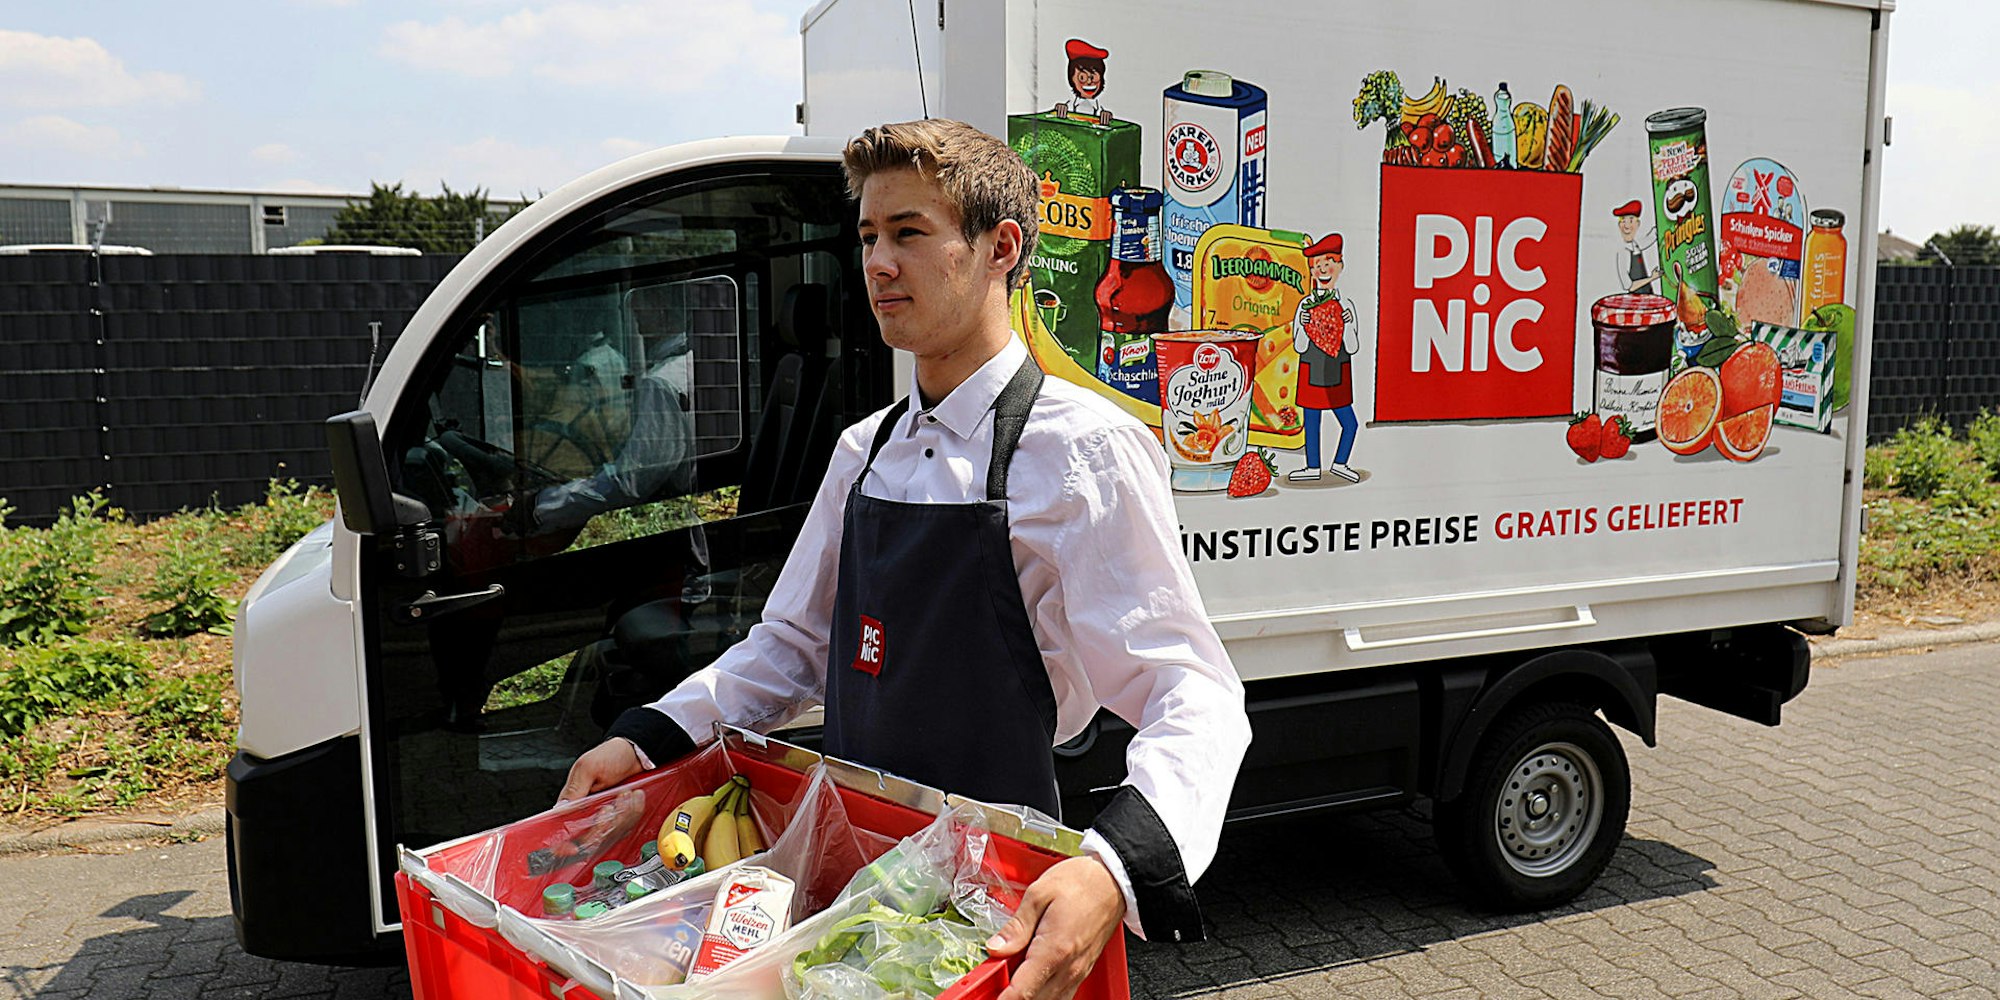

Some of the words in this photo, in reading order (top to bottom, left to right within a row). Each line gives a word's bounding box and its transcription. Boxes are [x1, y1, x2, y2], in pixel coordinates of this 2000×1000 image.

[1169, 126, 1216, 154] BÄREN
[1246, 129, 1265, 153] NEU
[1169, 158, 1215, 186] MARKE
[1171, 212, 1210, 232] frische
[1730, 218, 1764, 238] Schinken
[1764, 226, 1793, 243] Spicker
[1664, 212, 1706, 261] Pringles
[1414, 213, 1548, 292] PIC
[1686, 241, 1706, 258] SOUR
[1211, 255, 1305, 295] LEERDAMMER
[1809, 253, 1825, 299] fruits
[1208, 310, 1217, 325] 7
[1233, 295, 1280, 317] Original
[1188, 370, 1228, 387] Sahne
[1171, 377, 1237, 408] Joghurt
[1206, 396, 1225, 408] mild
[1370, 515, 1478, 550] PREISE
[1495, 507, 1598, 540] GRATIS
[1607, 498, 1744, 532] GELIEFERT
[863, 624, 880, 645] PIC
[730, 912, 769, 931] Weizen
[732, 924, 760, 939] MEHL
